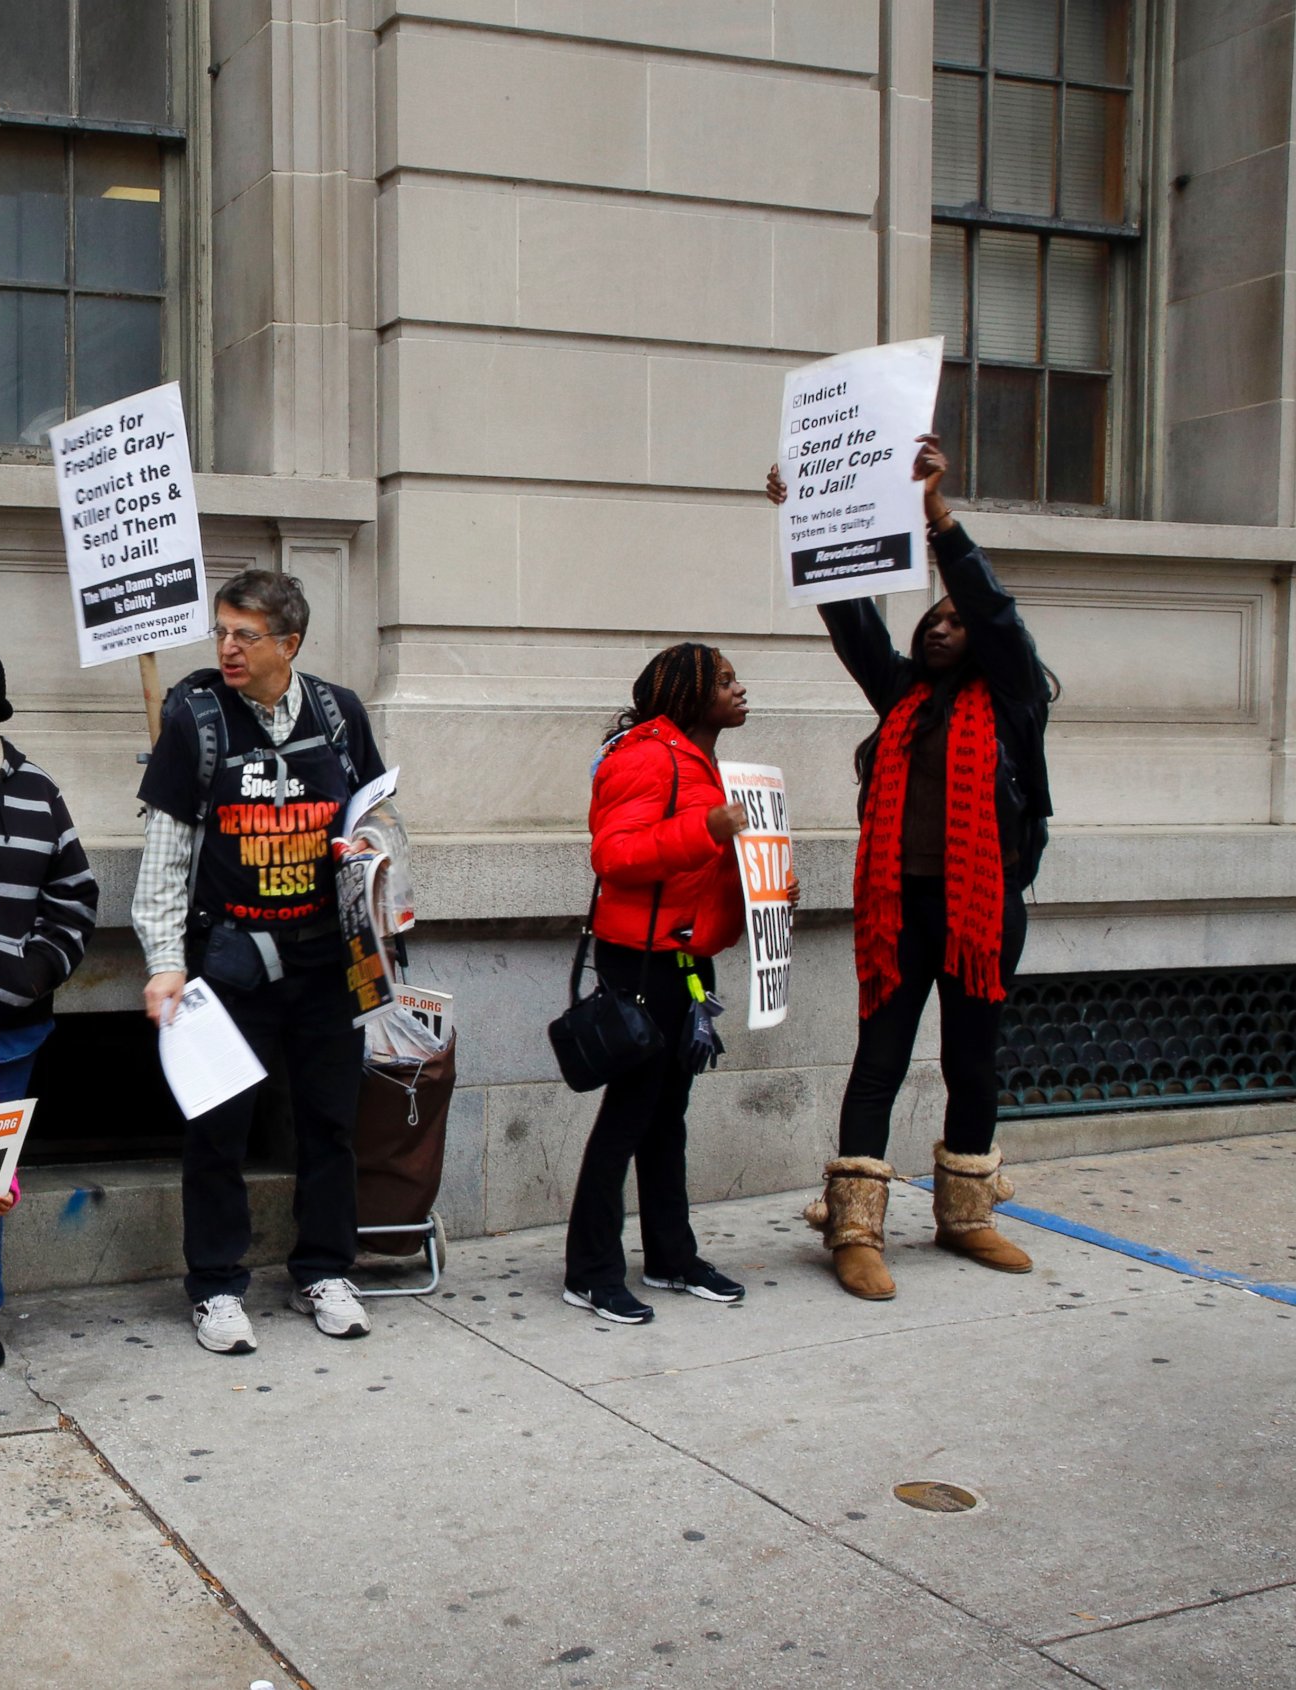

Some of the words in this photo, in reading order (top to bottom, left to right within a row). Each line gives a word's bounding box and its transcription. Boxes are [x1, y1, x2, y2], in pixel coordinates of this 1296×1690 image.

[803, 382, 846, 405] Indict!
[802, 406, 859, 430] Convict!
[60, 424, 113, 455] Justice
[120, 414, 144, 432] for
[800, 433, 843, 457] Send
[847, 429, 876, 446] the
[64, 446, 117, 478] Freddie
[798, 457, 844, 479] Killer
[848, 448, 893, 467] Cops
[76, 472, 133, 505] Convict
[140, 464, 171, 483] the
[799, 485, 814, 499] to
[820, 473, 856, 495] Jail!
[72, 507, 110, 530] Killer
[115, 491, 161, 515] Cops
[168, 483, 182, 500] &
[790, 515, 808, 525] The
[811, 508, 842, 521] whole
[845, 502, 876, 515] damn
[83, 524, 118, 550] Send
[123, 512, 176, 536] Them
[791, 526, 825, 541] system
[829, 523, 838, 532] is
[101, 553, 115, 568] to
[120, 537, 159, 562] Jail!
[83, 592, 100, 605] The
[124, 577, 153, 593] Damn
[155, 568, 192, 587] System
[114, 602, 123, 614] Is
[123, 592, 156, 612] Guilty!
[135, 611, 189, 631] newspaper
[102, 625, 187, 651] www.revcom.us
[770, 791, 789, 831] UP!
[240, 830, 328, 866] NOTHING
[258, 864, 316, 896] LESS!
[744, 841, 790, 892] STOP
